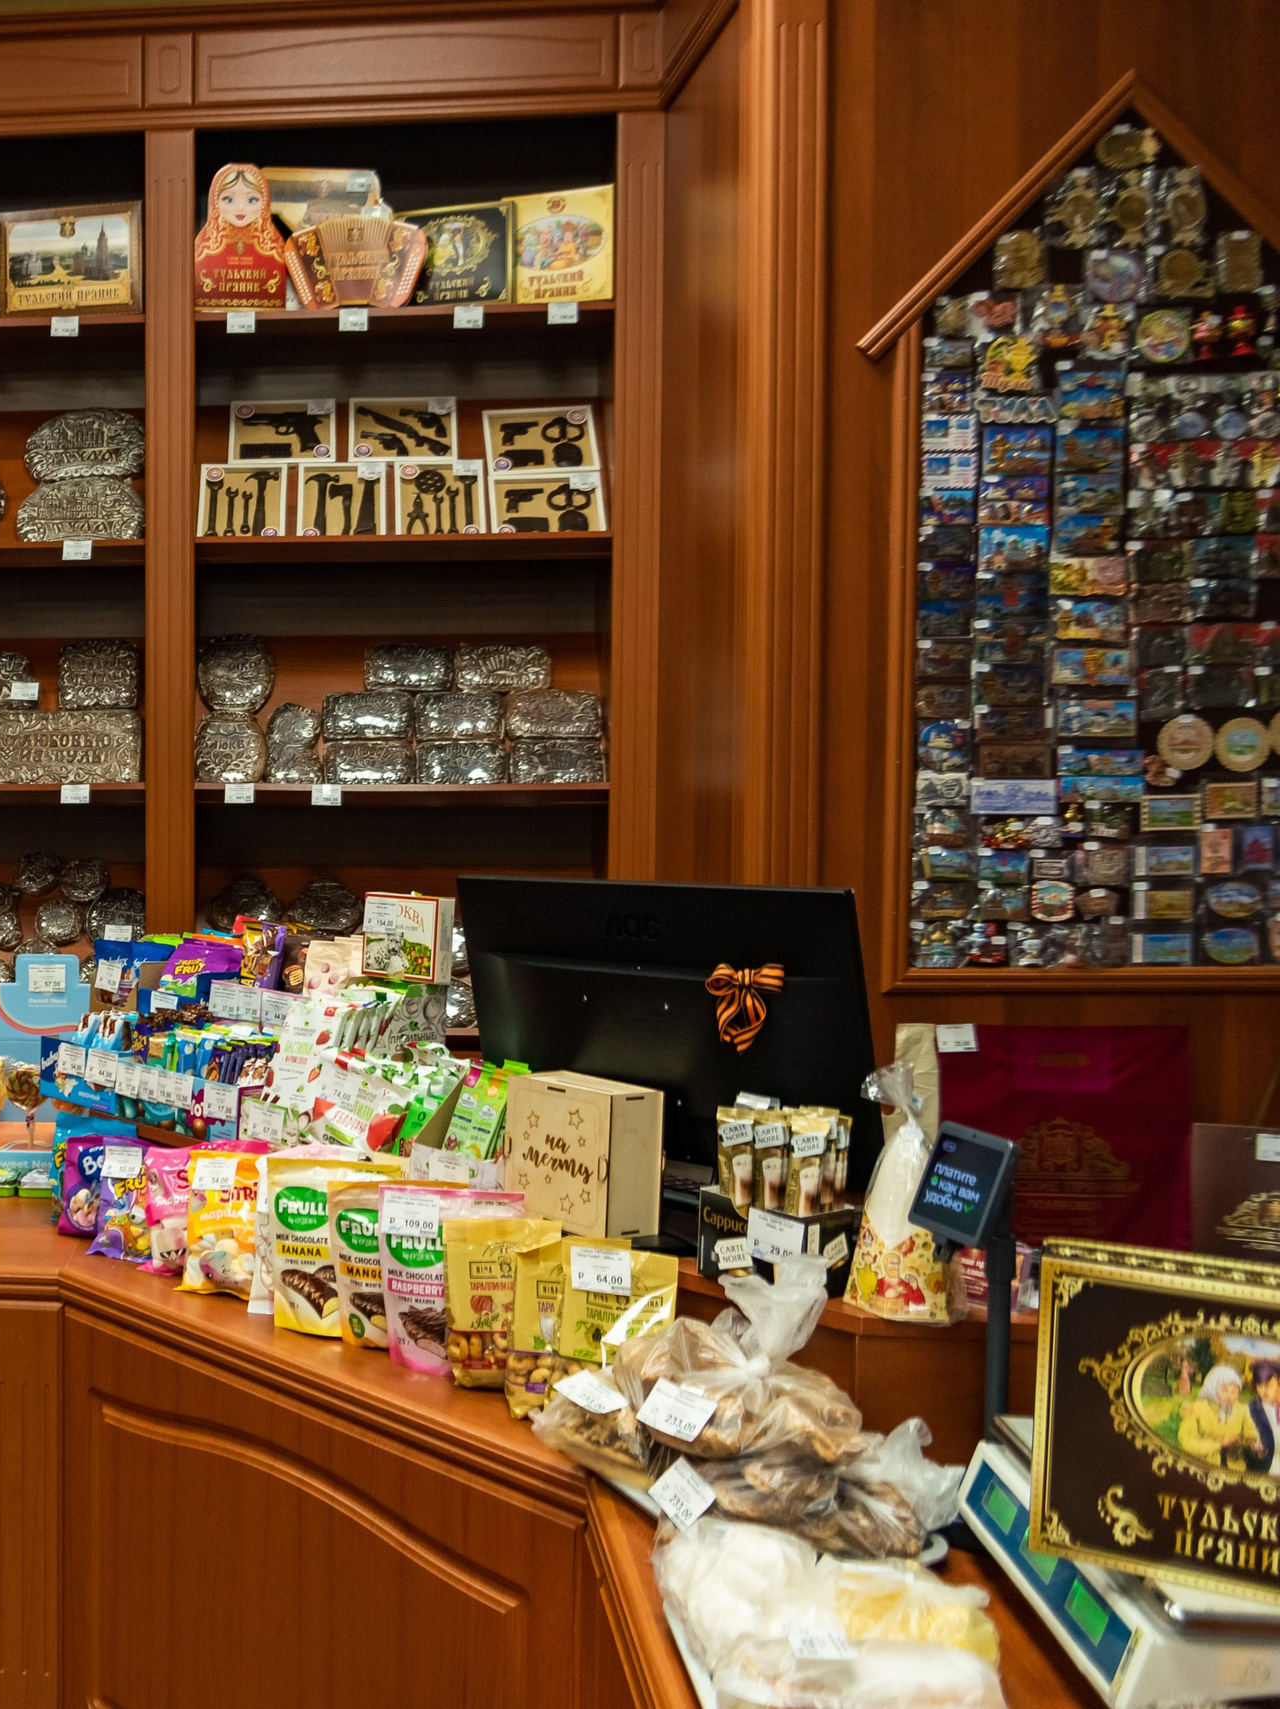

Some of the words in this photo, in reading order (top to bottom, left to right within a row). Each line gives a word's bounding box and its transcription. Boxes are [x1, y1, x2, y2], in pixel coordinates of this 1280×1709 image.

[603, 913, 662, 940] AOC
[722, 1123, 747, 1135] CARTE
[755, 1127, 778, 1137] CARTE
[725, 1131, 749, 1142] NOIRE
[757, 1134, 780, 1144] NOIRE
[796, 1136, 819, 1146] CARTE
[545, 1133, 570, 1154] на
[797, 1143, 820, 1154] NOIRE
[523, 1147, 594, 1184] мечту
[934, 1161, 977, 1186] платите
[939, 1179, 958, 1195] как
[958, 1186, 980, 1203] вам
[923, 1188, 963, 1213] удобно
[405, 1219, 434, 1230] 109,00
[276, 1233, 290, 1242] MILK
[291, 1234, 328, 1246] CHOCOLATE
[281, 1245, 322, 1257] BANANA
[720, 1245, 746, 1254] CARTE
[339, 1253, 352, 1263] MILK
[722, 1253, 747, 1263] NOIRE
[388, 1269, 403, 1278] MILK
[475, 1266, 493, 1274] NINA
[596, 1274, 623, 1286] 64,00
[391, 1280, 443, 1296] RASPBERRY
[665, 1414, 696, 1433] 233,00
[668, 1494, 693, 1521] 233,00
